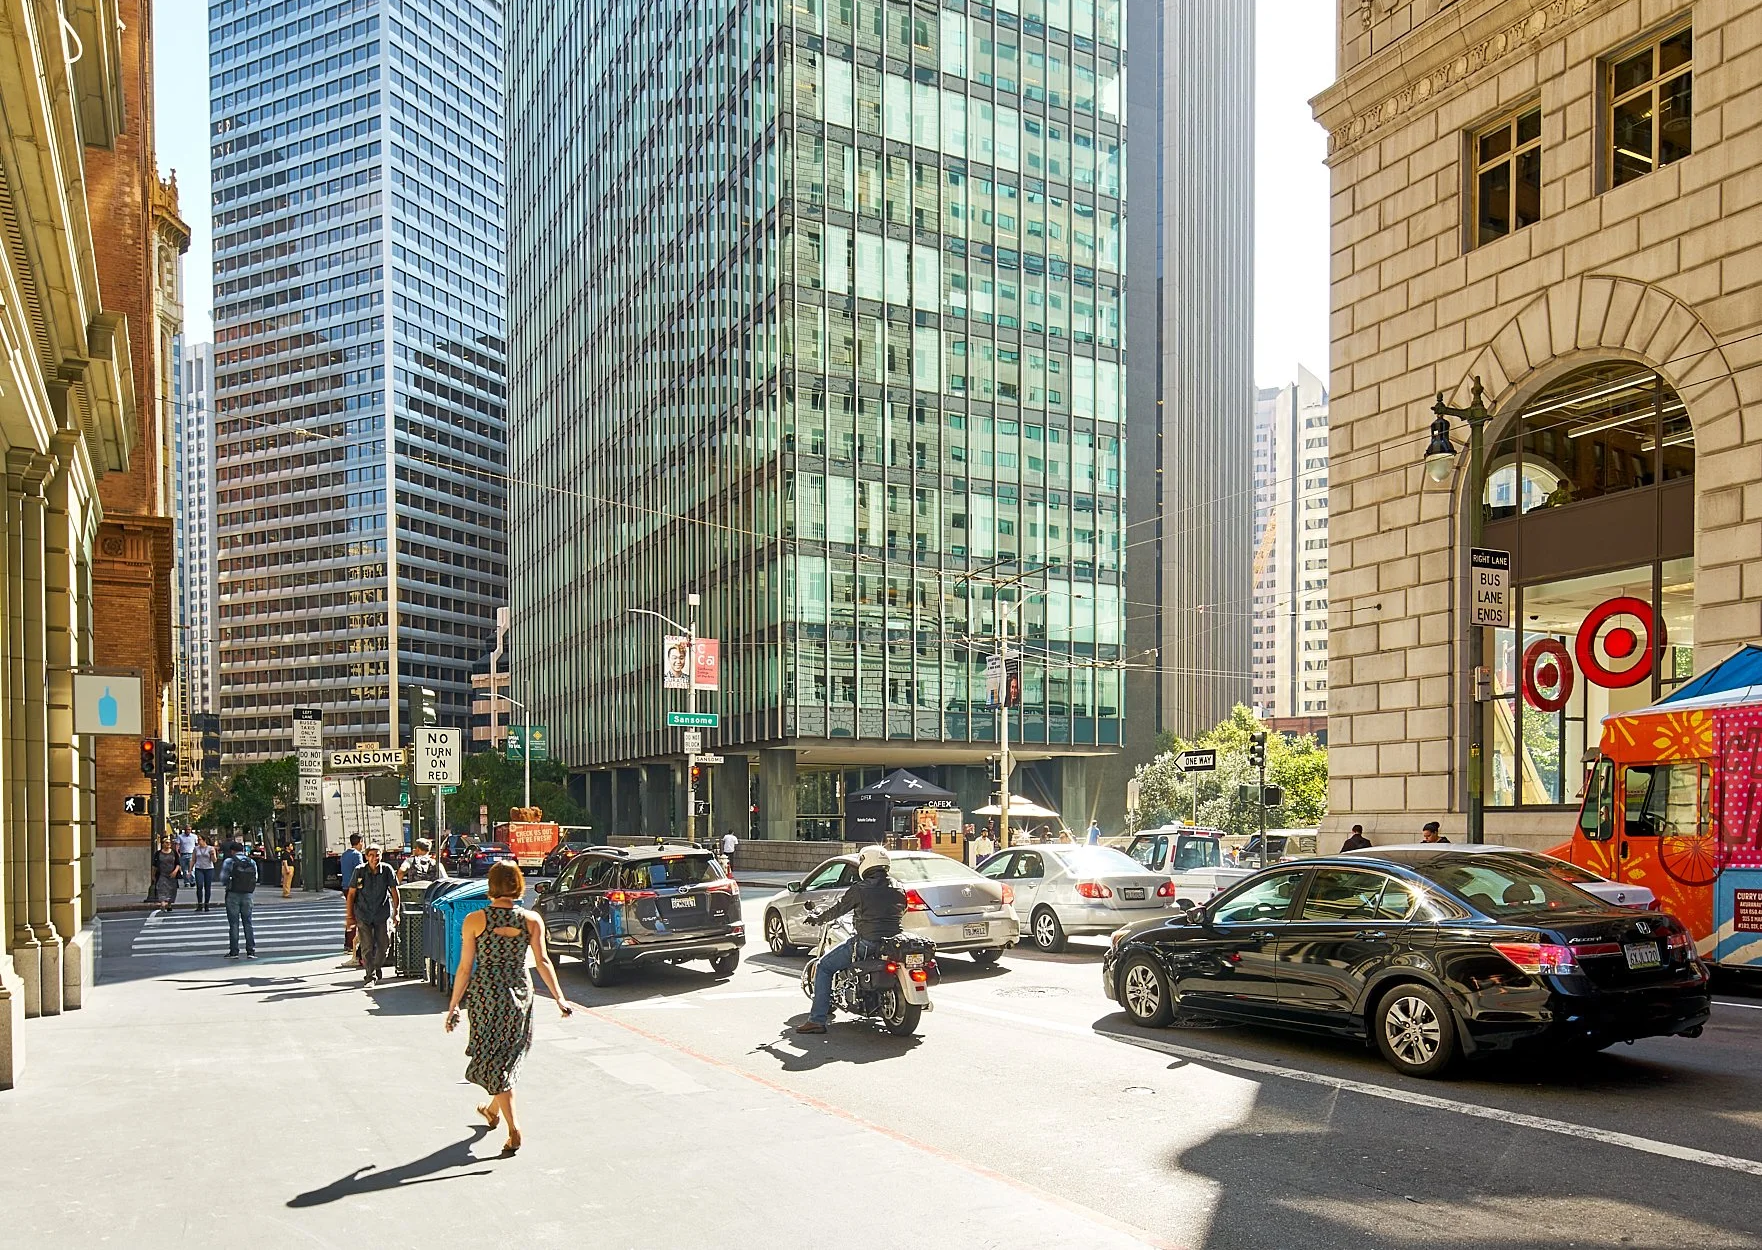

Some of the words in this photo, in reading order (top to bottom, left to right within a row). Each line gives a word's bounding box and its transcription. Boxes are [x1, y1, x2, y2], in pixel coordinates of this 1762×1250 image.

[1473, 554, 1490, 564] RIGHT
[1491, 557, 1508, 566] LANE
[1480, 573, 1501, 587] BUS
[1478, 590, 1503, 605] LANE
[1478, 608, 1503, 622] ENDS
[673, 715, 713, 724] Sansome
[428, 734, 448, 744] NO
[424, 748, 452, 757] TURN
[334, 752, 403, 764] SANSOME
[1186, 757, 1198, 766] ONE
[1198, 756, 1212, 764] WAY
[430, 760, 446, 768] ON
[428, 772, 448, 780] RED
